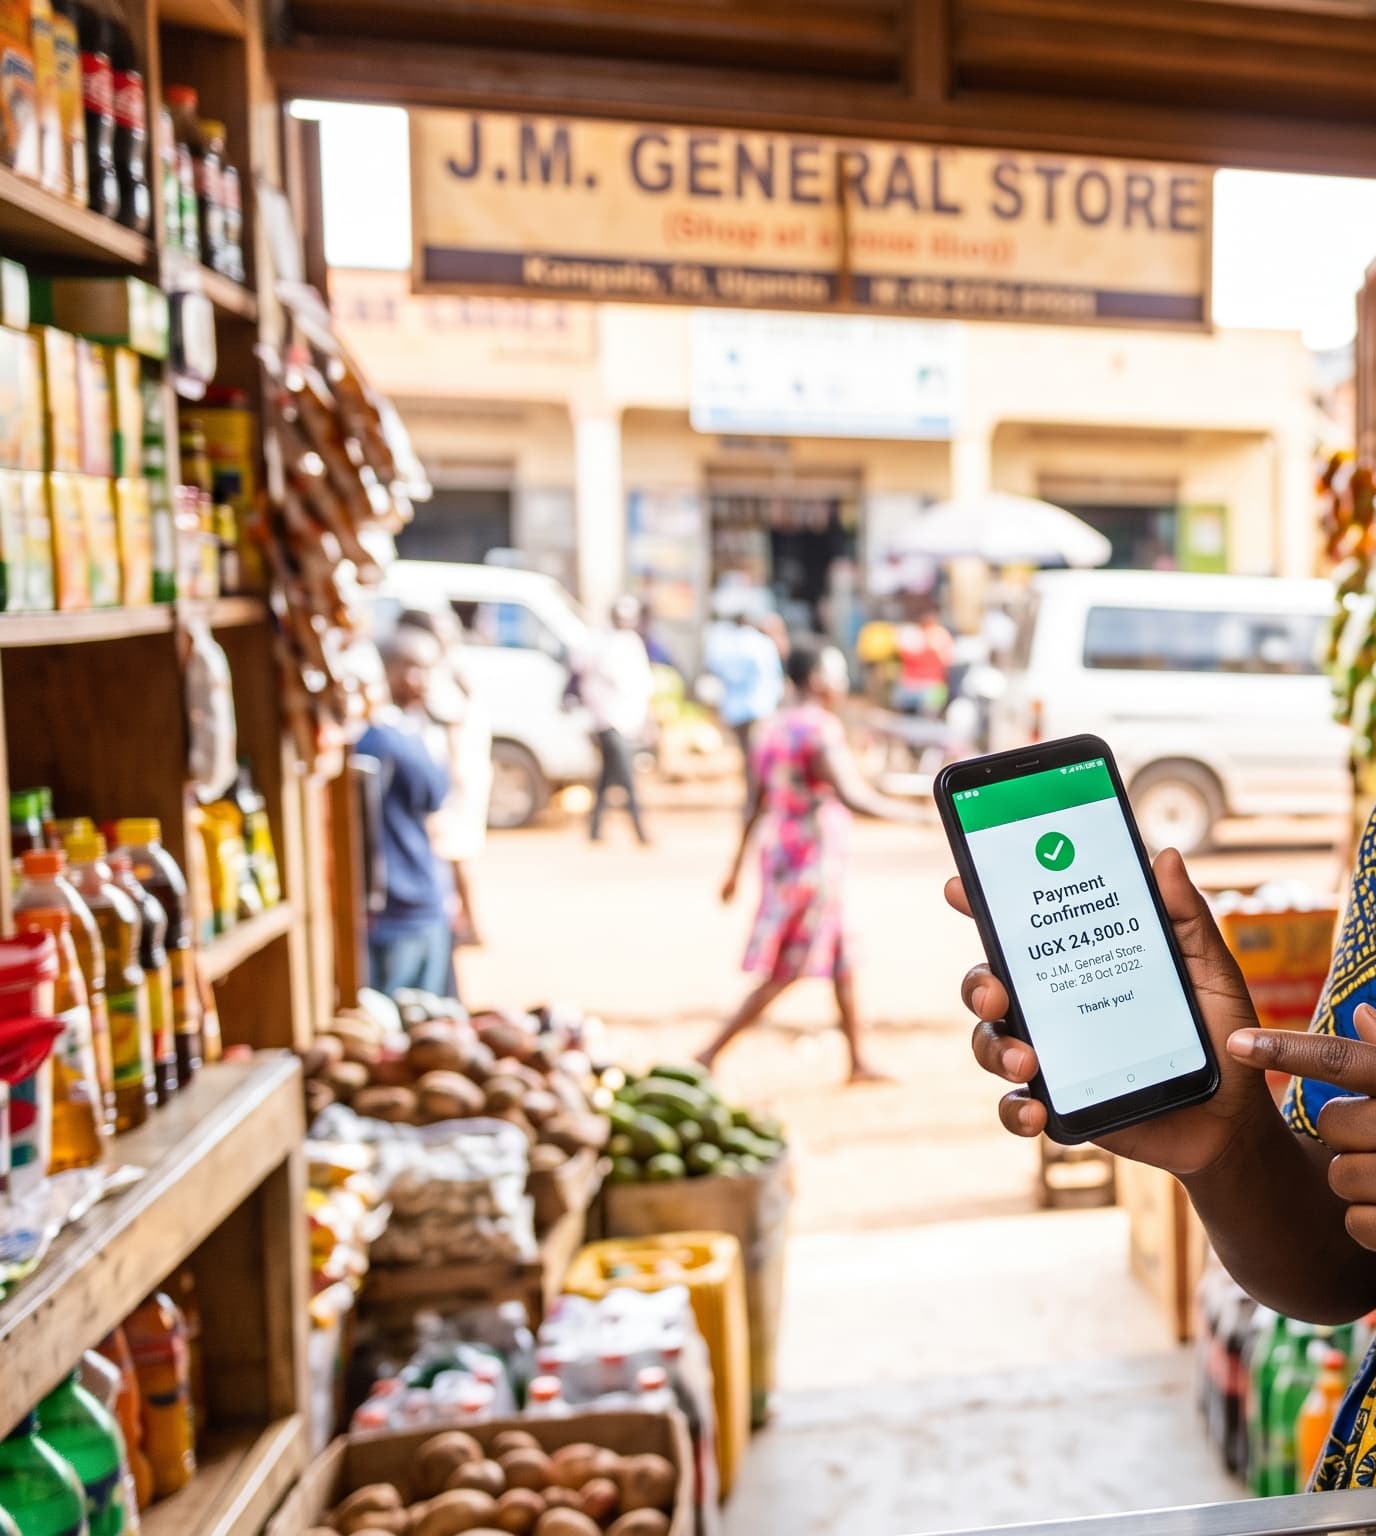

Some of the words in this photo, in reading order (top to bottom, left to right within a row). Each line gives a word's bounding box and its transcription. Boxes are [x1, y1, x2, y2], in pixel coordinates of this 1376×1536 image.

[446, 118, 598, 189] J.M.
[629, 132, 963, 215] GENERAL
[991, 160, 1200, 233] STORE
[1033, 875, 1106, 905] Payment
[1030, 892, 1120, 928] Confirmed!
[1028, 938, 1066, 960] UGX
[1036, 971, 1048, 982] to
[1050, 963, 1073, 978] J.M.
[1074, 950, 1114, 970] General
[1115, 944, 1146, 958] Store.
[1050, 979, 1078, 993] Date:
[1079, 973, 1093, 985] 28
[1095, 968, 1113, 980] Oct
[1114, 959, 1143, 975] 2022.
[1077, 997, 1111, 1015] Thank
[1112, 990, 1135, 1007] you!
